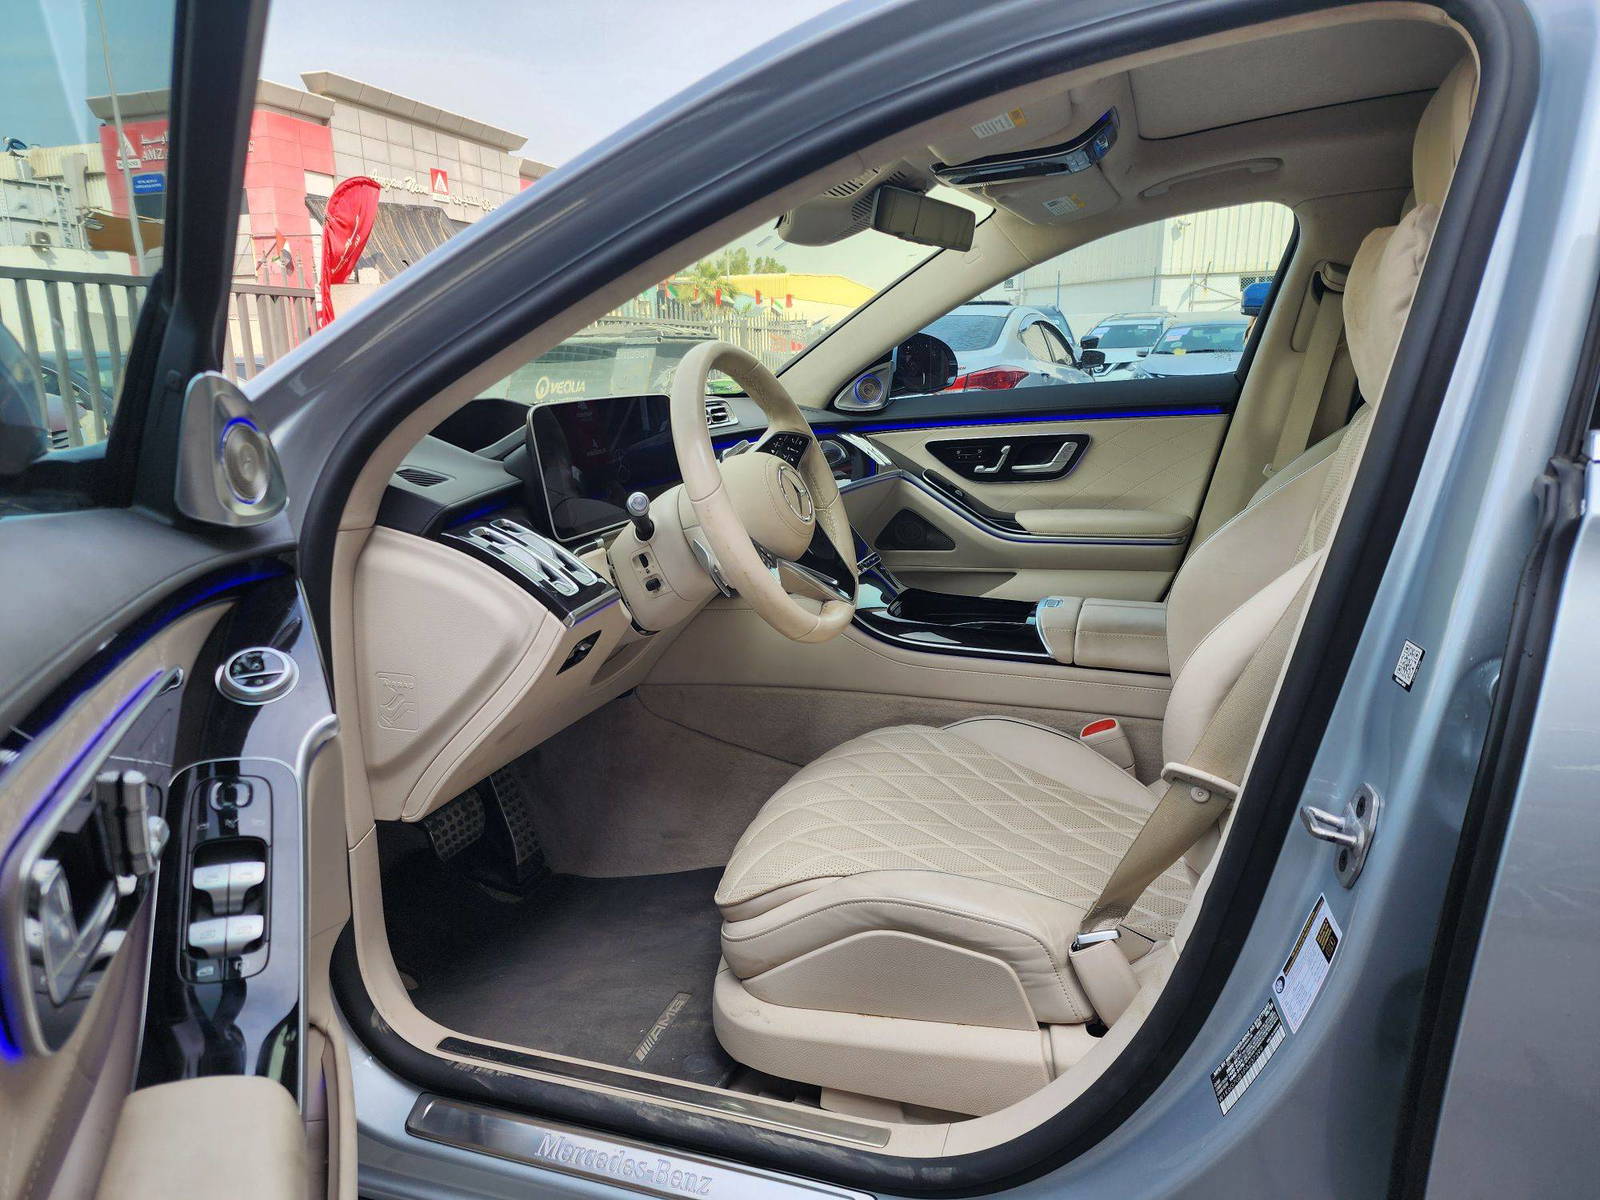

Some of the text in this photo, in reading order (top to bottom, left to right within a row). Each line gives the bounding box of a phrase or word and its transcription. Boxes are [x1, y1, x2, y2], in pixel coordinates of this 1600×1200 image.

[142, 147, 169, 162] AMZ
[550, 378, 586, 394] VEOLIA
[534, 1132, 713, 1195] Mercedes-Benz
